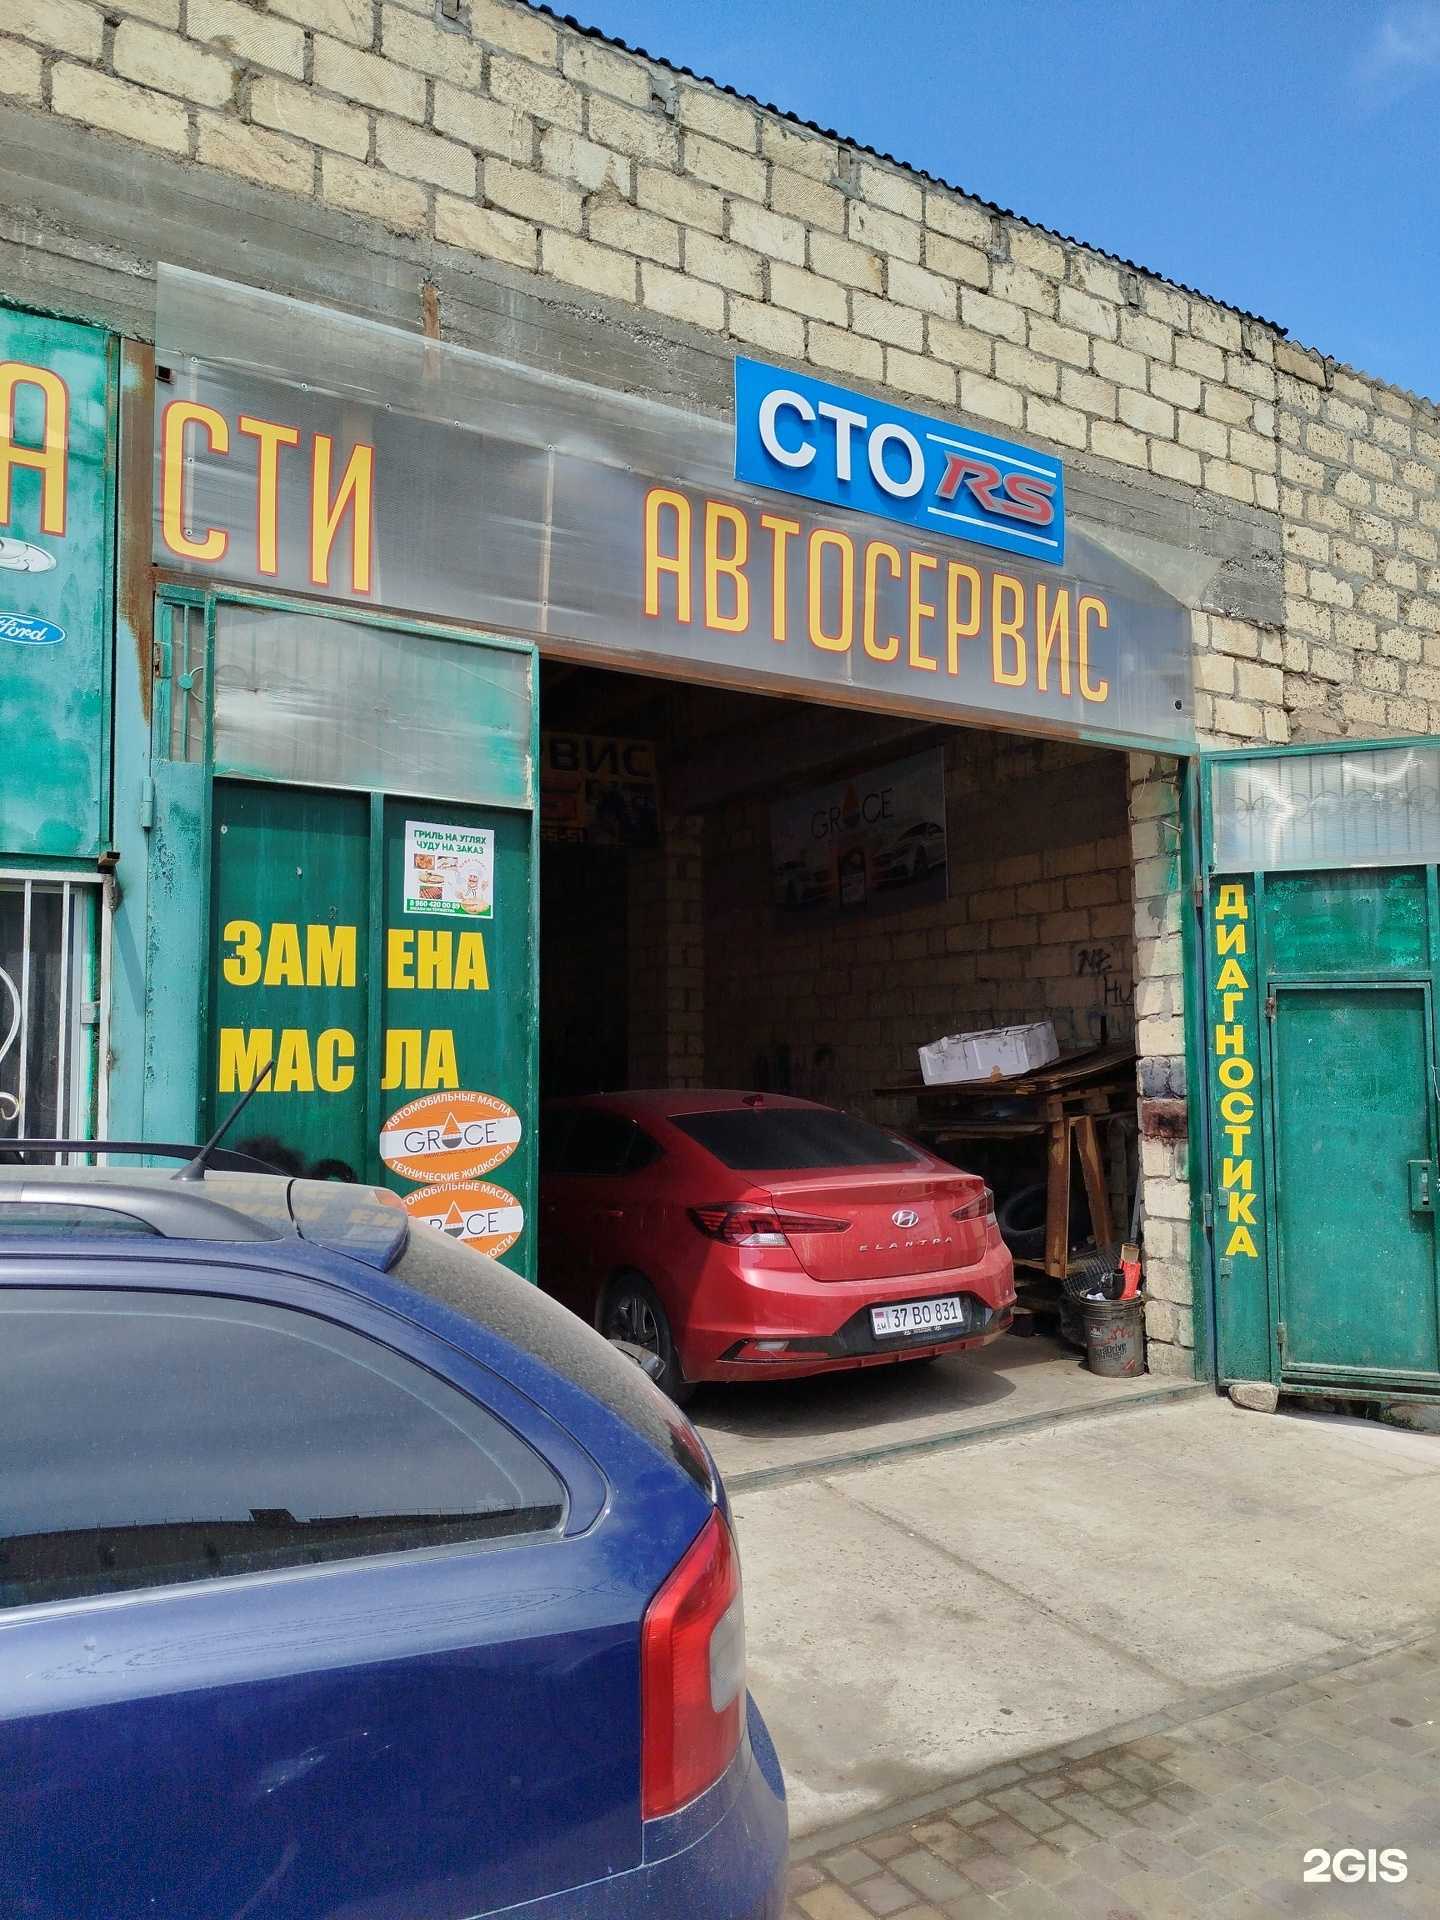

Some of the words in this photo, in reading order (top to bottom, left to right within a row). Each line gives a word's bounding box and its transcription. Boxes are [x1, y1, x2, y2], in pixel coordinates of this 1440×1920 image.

[0, 361, 69, 537] А
[758, 390, 925, 499] СТО
[936, 450, 1057, 527] RS
[161, 400, 374, 596] СТИ
[643, 487, 1109, 702] АВТОСЕРВИС
[414, 830, 444, 840] ГРИЛЬ
[445, 833, 459, 842] НА
[459, 834, 487, 845] УГЛЯХ
[416, 840, 440, 851] ЧУДУ
[442, 843, 454, 852] НА
[456, 844, 484, 855] ЗАКАЗ
[1215, 883, 1259, 1259] ДИАГНОСТИКА
[386, 1092, 476, 1130] АВТОМОБИЛЬНЫЕ
[477, 1094, 512, 1116] МАСЛА
[391, 1160, 460, 1181] ТЕХНИЧЕСКИЕ
[461, 1145, 514, 1178] ЖИДКОСТИ
[404, 1182, 480, 1206] ОМОБИЛЬНЫЕ
[480, 1183, 514, 1206] МАСЛА
[859, 1236, 953, 1252] ELANTRA
[891, 1308, 908, 1328] 37
[911, 1305, 932, 1325] BO
[934, 1301, 958, 1322] 831
